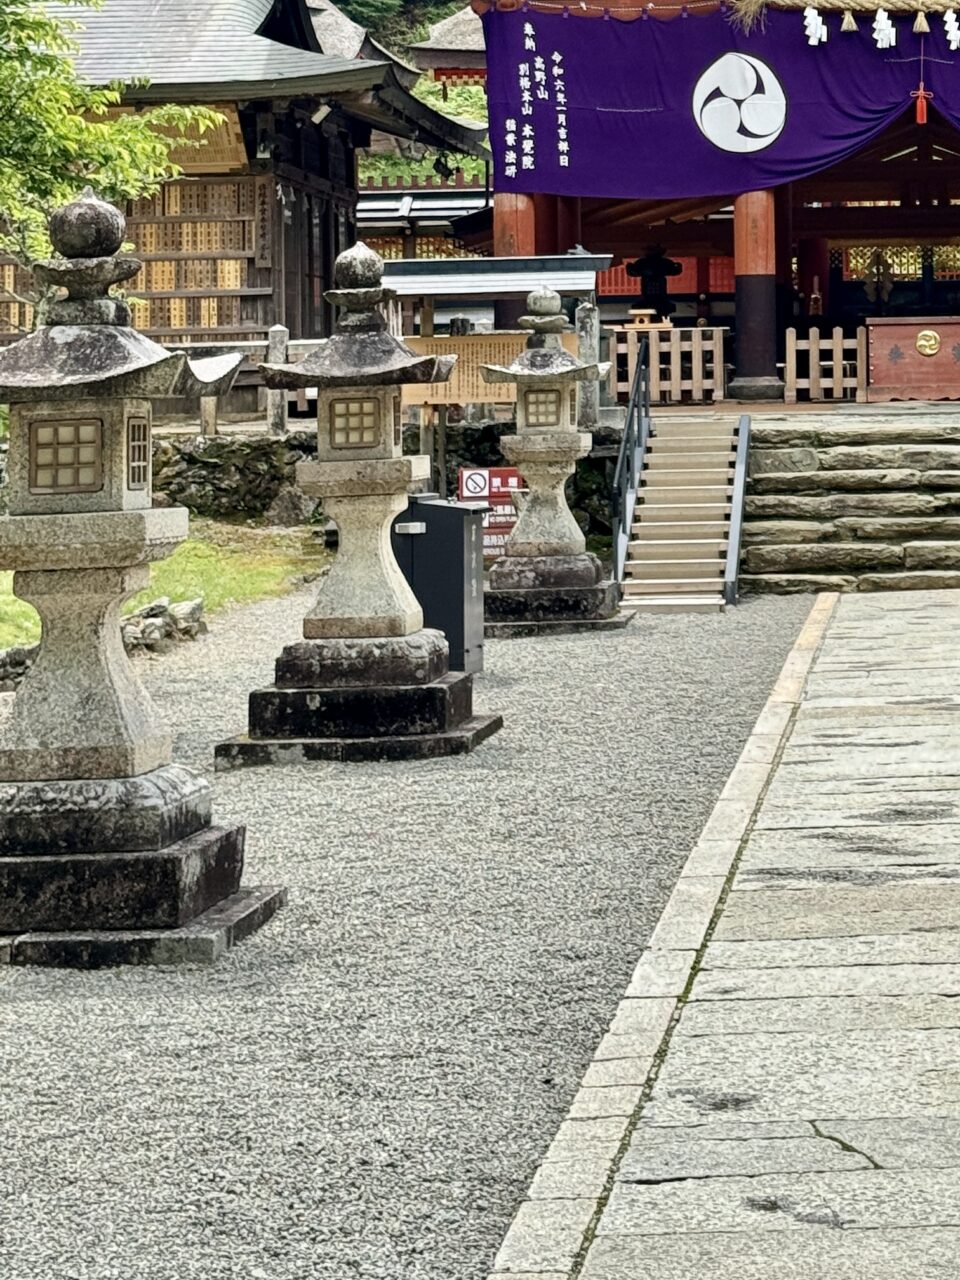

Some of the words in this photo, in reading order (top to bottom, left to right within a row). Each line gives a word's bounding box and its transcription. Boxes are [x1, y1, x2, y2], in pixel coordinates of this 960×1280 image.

[523, 22, 536, 52] 奉納
[518, 62, 534, 116] 別格本山
[534, 55, 549, 100] 高野山
[551, 51, 570, 167] 令和六年一月吉祥日
